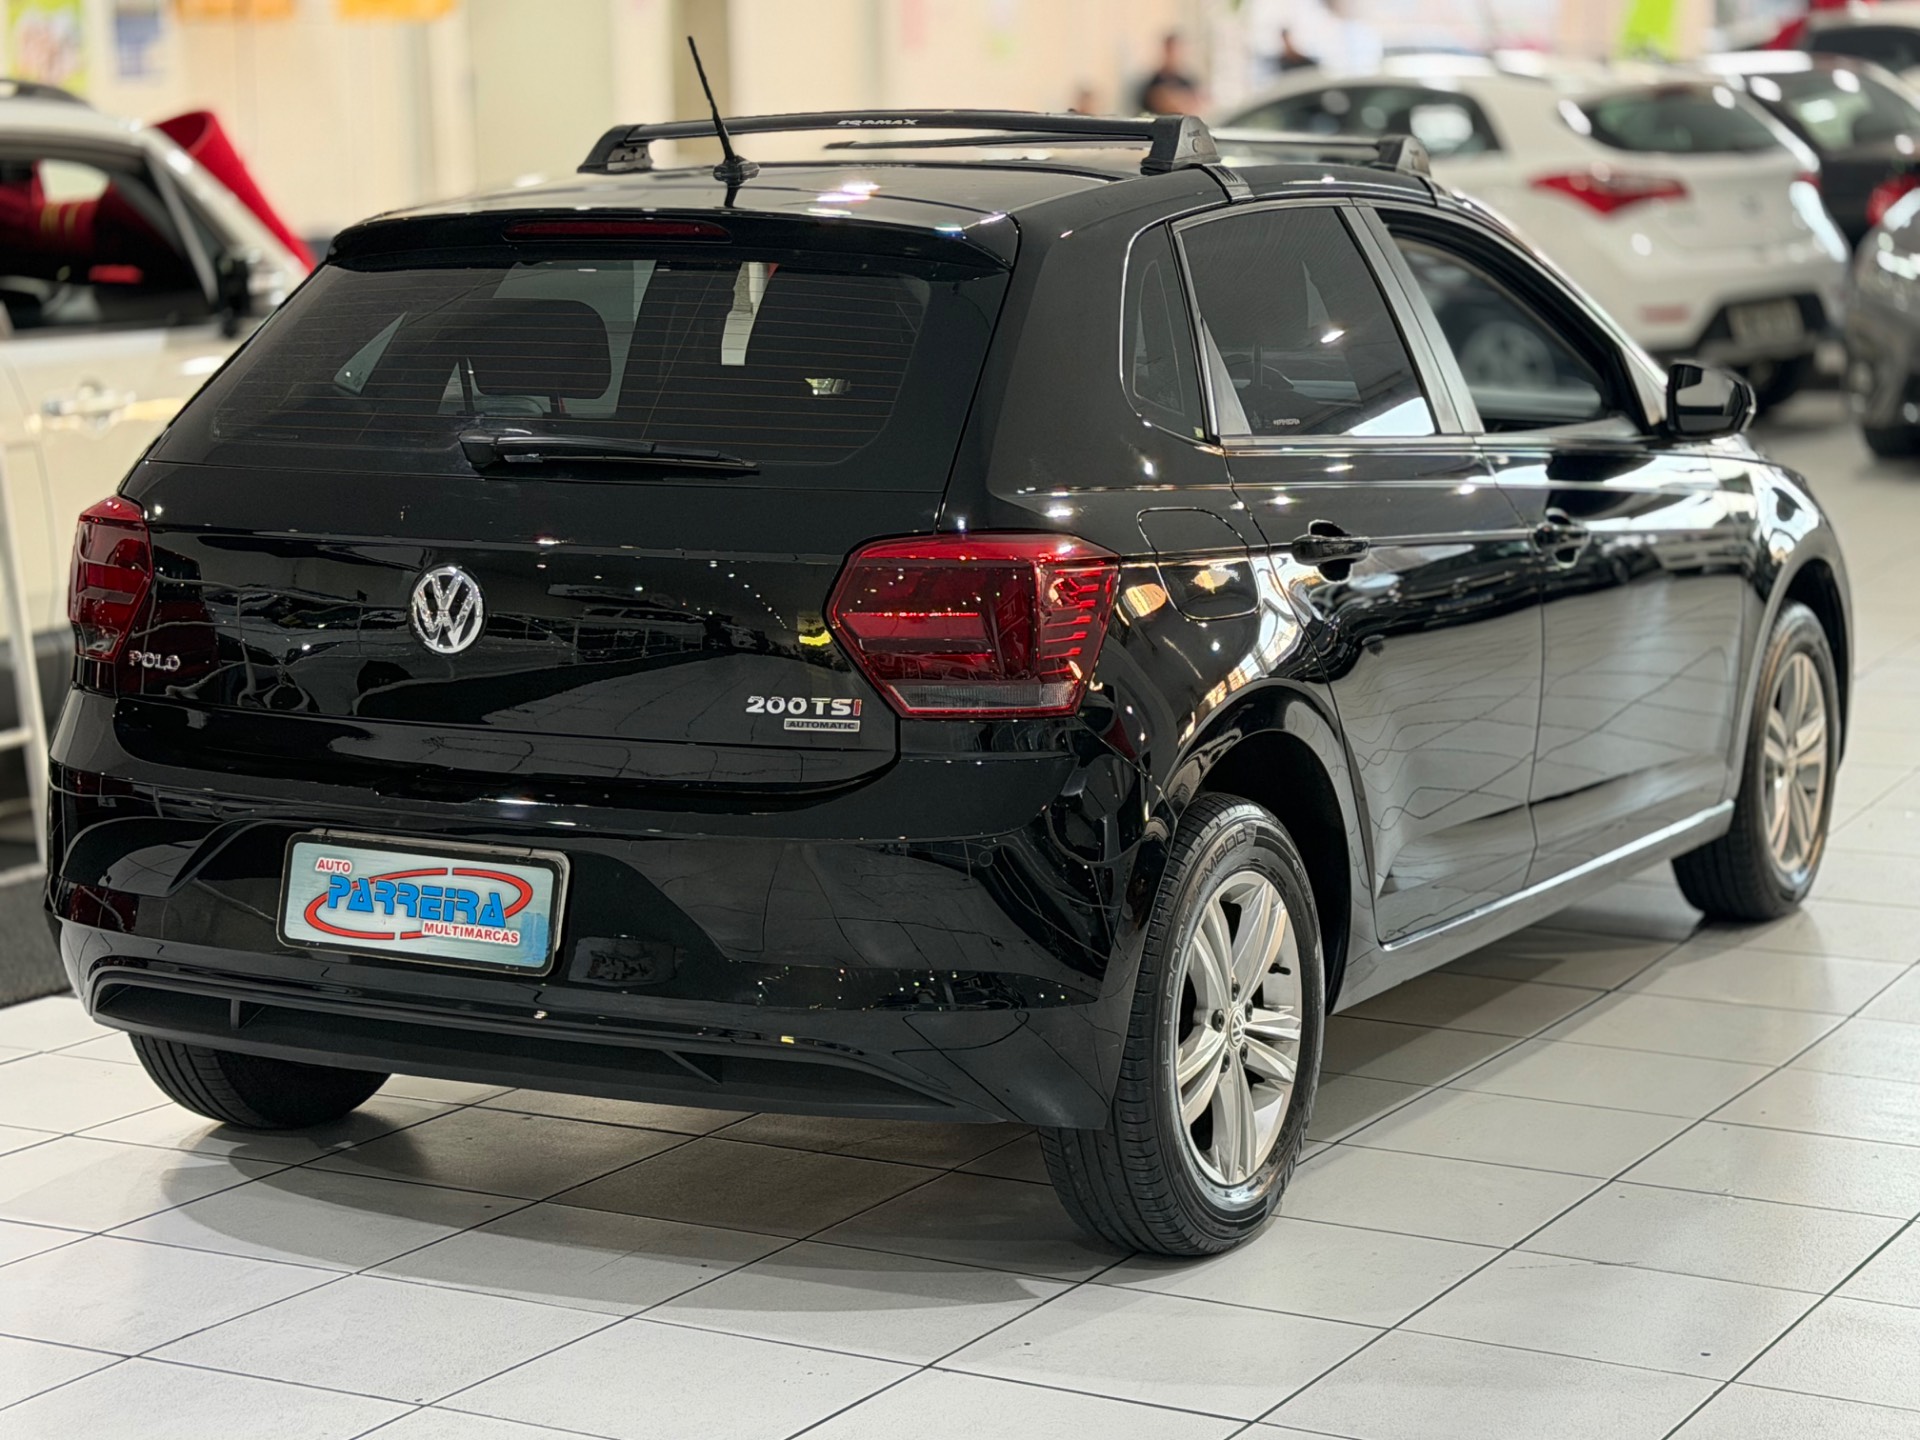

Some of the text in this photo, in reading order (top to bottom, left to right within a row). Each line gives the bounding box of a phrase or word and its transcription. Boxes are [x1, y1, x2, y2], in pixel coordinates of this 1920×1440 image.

[128, 650, 181, 672] POLO
[789, 721, 856, 729] AUTOMATIC
[316, 859, 351, 873] AUTO
[328, 875, 506, 927] PARREIRA
[423, 922, 519, 944] MULTIMARCAS
